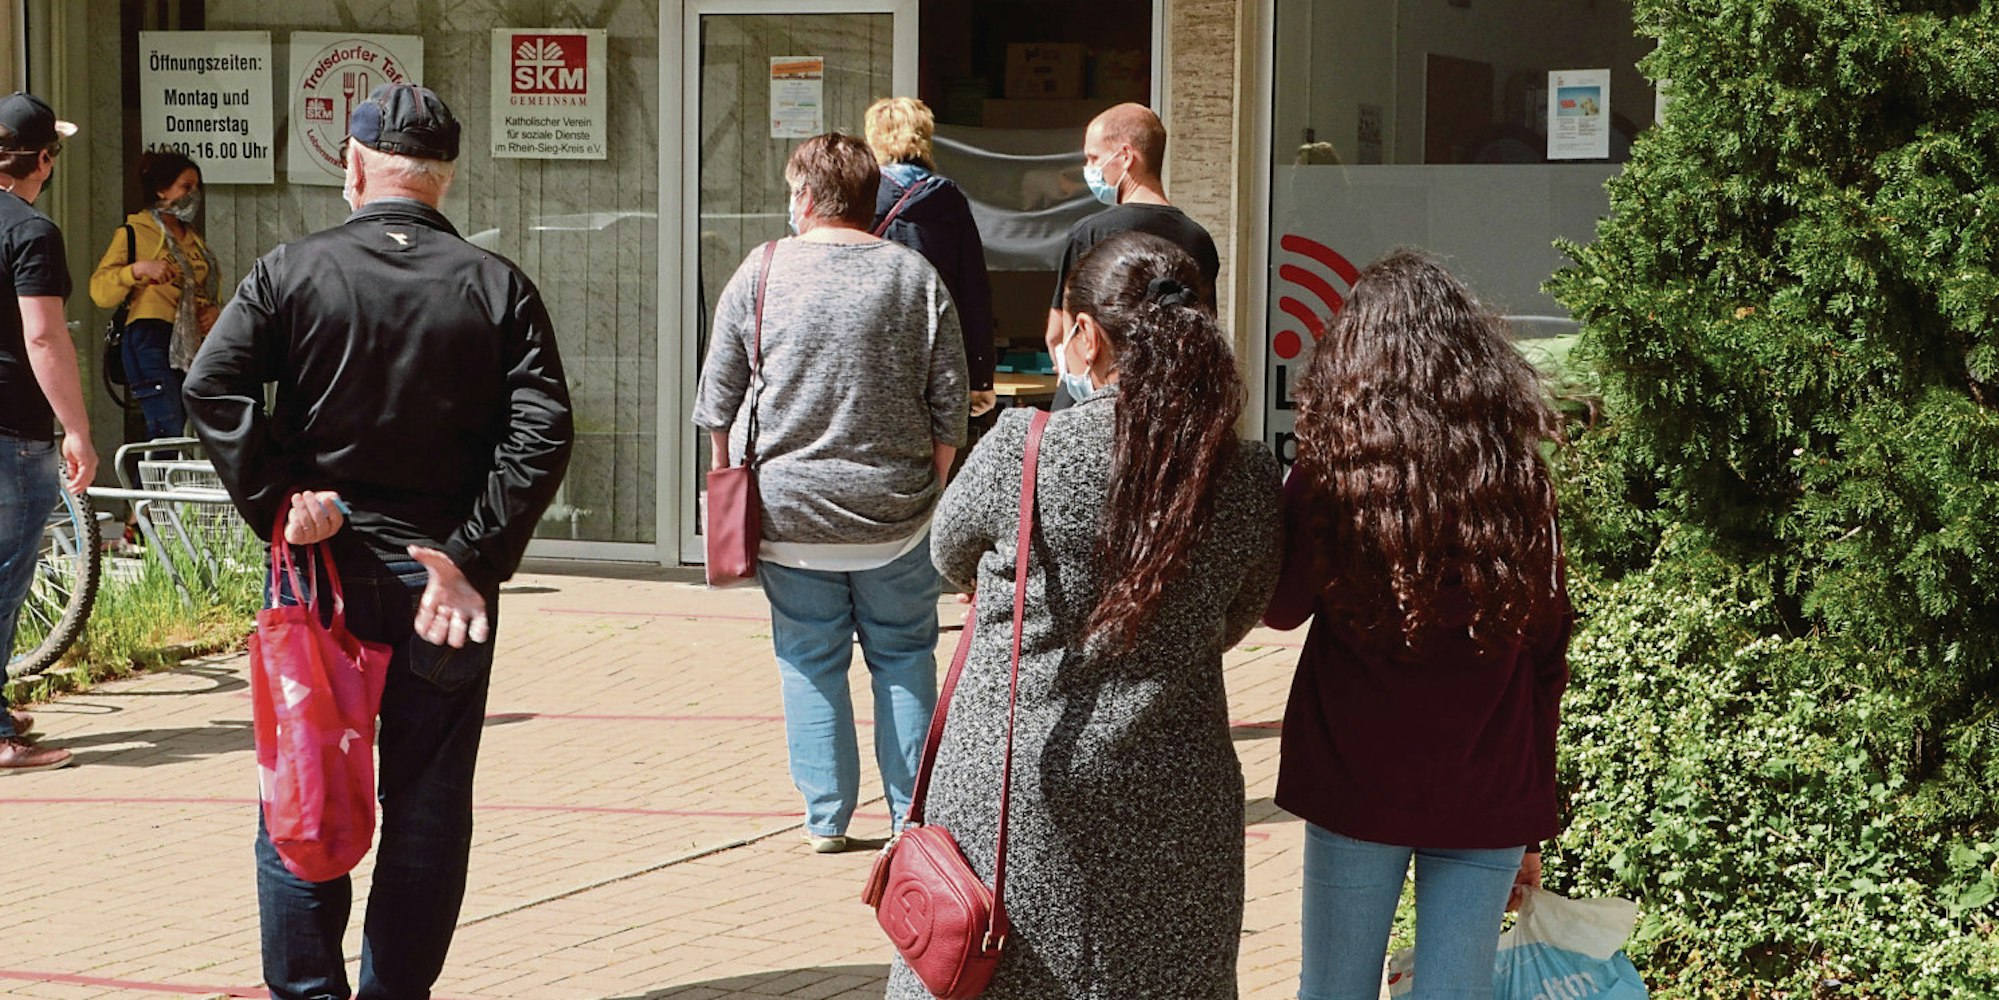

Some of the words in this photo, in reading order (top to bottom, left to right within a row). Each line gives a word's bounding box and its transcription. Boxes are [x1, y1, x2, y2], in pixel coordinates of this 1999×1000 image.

[149, 50, 262, 74] Öffnungszeiten:
[303, 46, 378, 90] Troisdorfer
[381, 57, 404, 84] Taf
[515, 67, 585, 90] SKM
[164, 89, 218, 109] Montag
[223, 89, 249, 106] und
[510, 96, 588, 107] GEMEINSAM
[306, 109, 332, 118] SKM
[505, 116, 561, 127] Katholischer
[562, 116, 592, 127] Verein
[166, 115, 249, 136] Donnerstag
[507, 130, 519, 139] für
[521, 130, 553, 140] soziale
[555, 130, 590, 141] Dienste
[242, 142, 268, 159] Uhr
[307, 129, 343, 168] Lebensmi
[495, 143, 507, 152] im
[508, 143, 585, 155] Rhein-Sieg-Kreis
